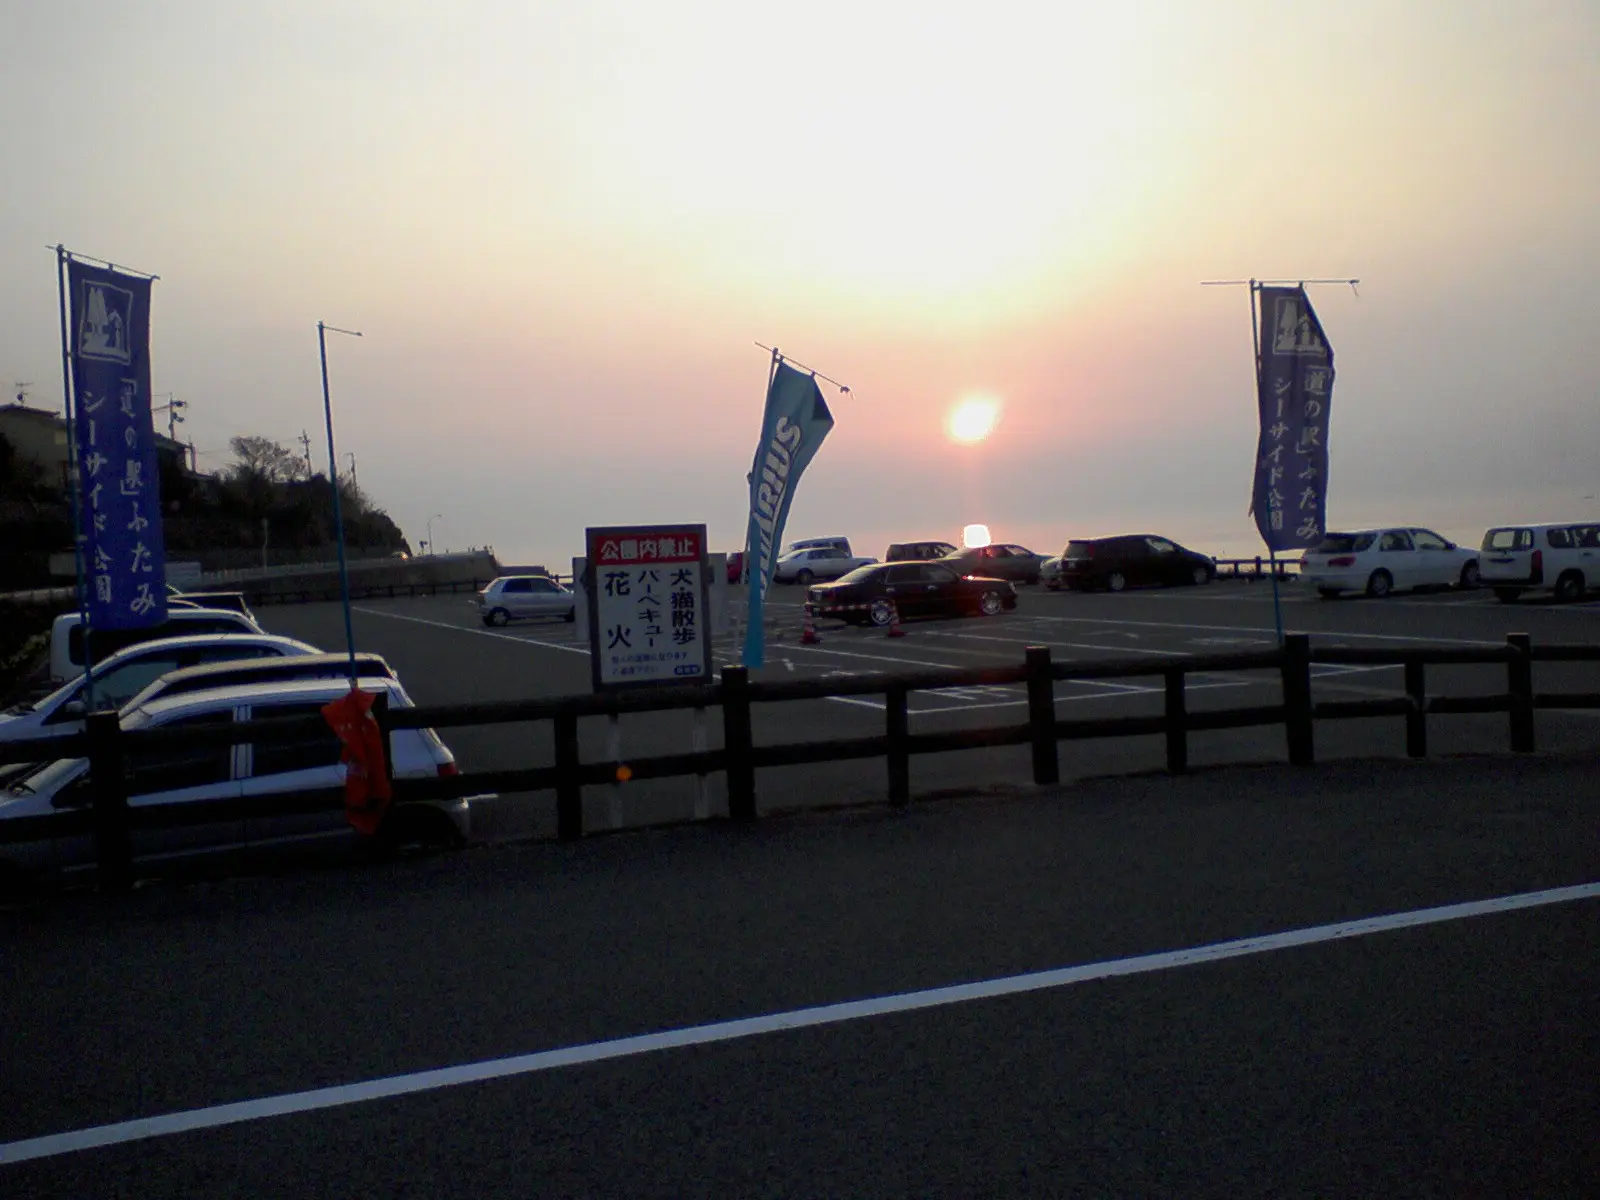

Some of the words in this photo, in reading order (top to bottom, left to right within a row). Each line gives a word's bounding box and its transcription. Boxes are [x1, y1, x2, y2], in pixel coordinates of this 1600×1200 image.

[600, 536, 695, 561] 公園内禁止
